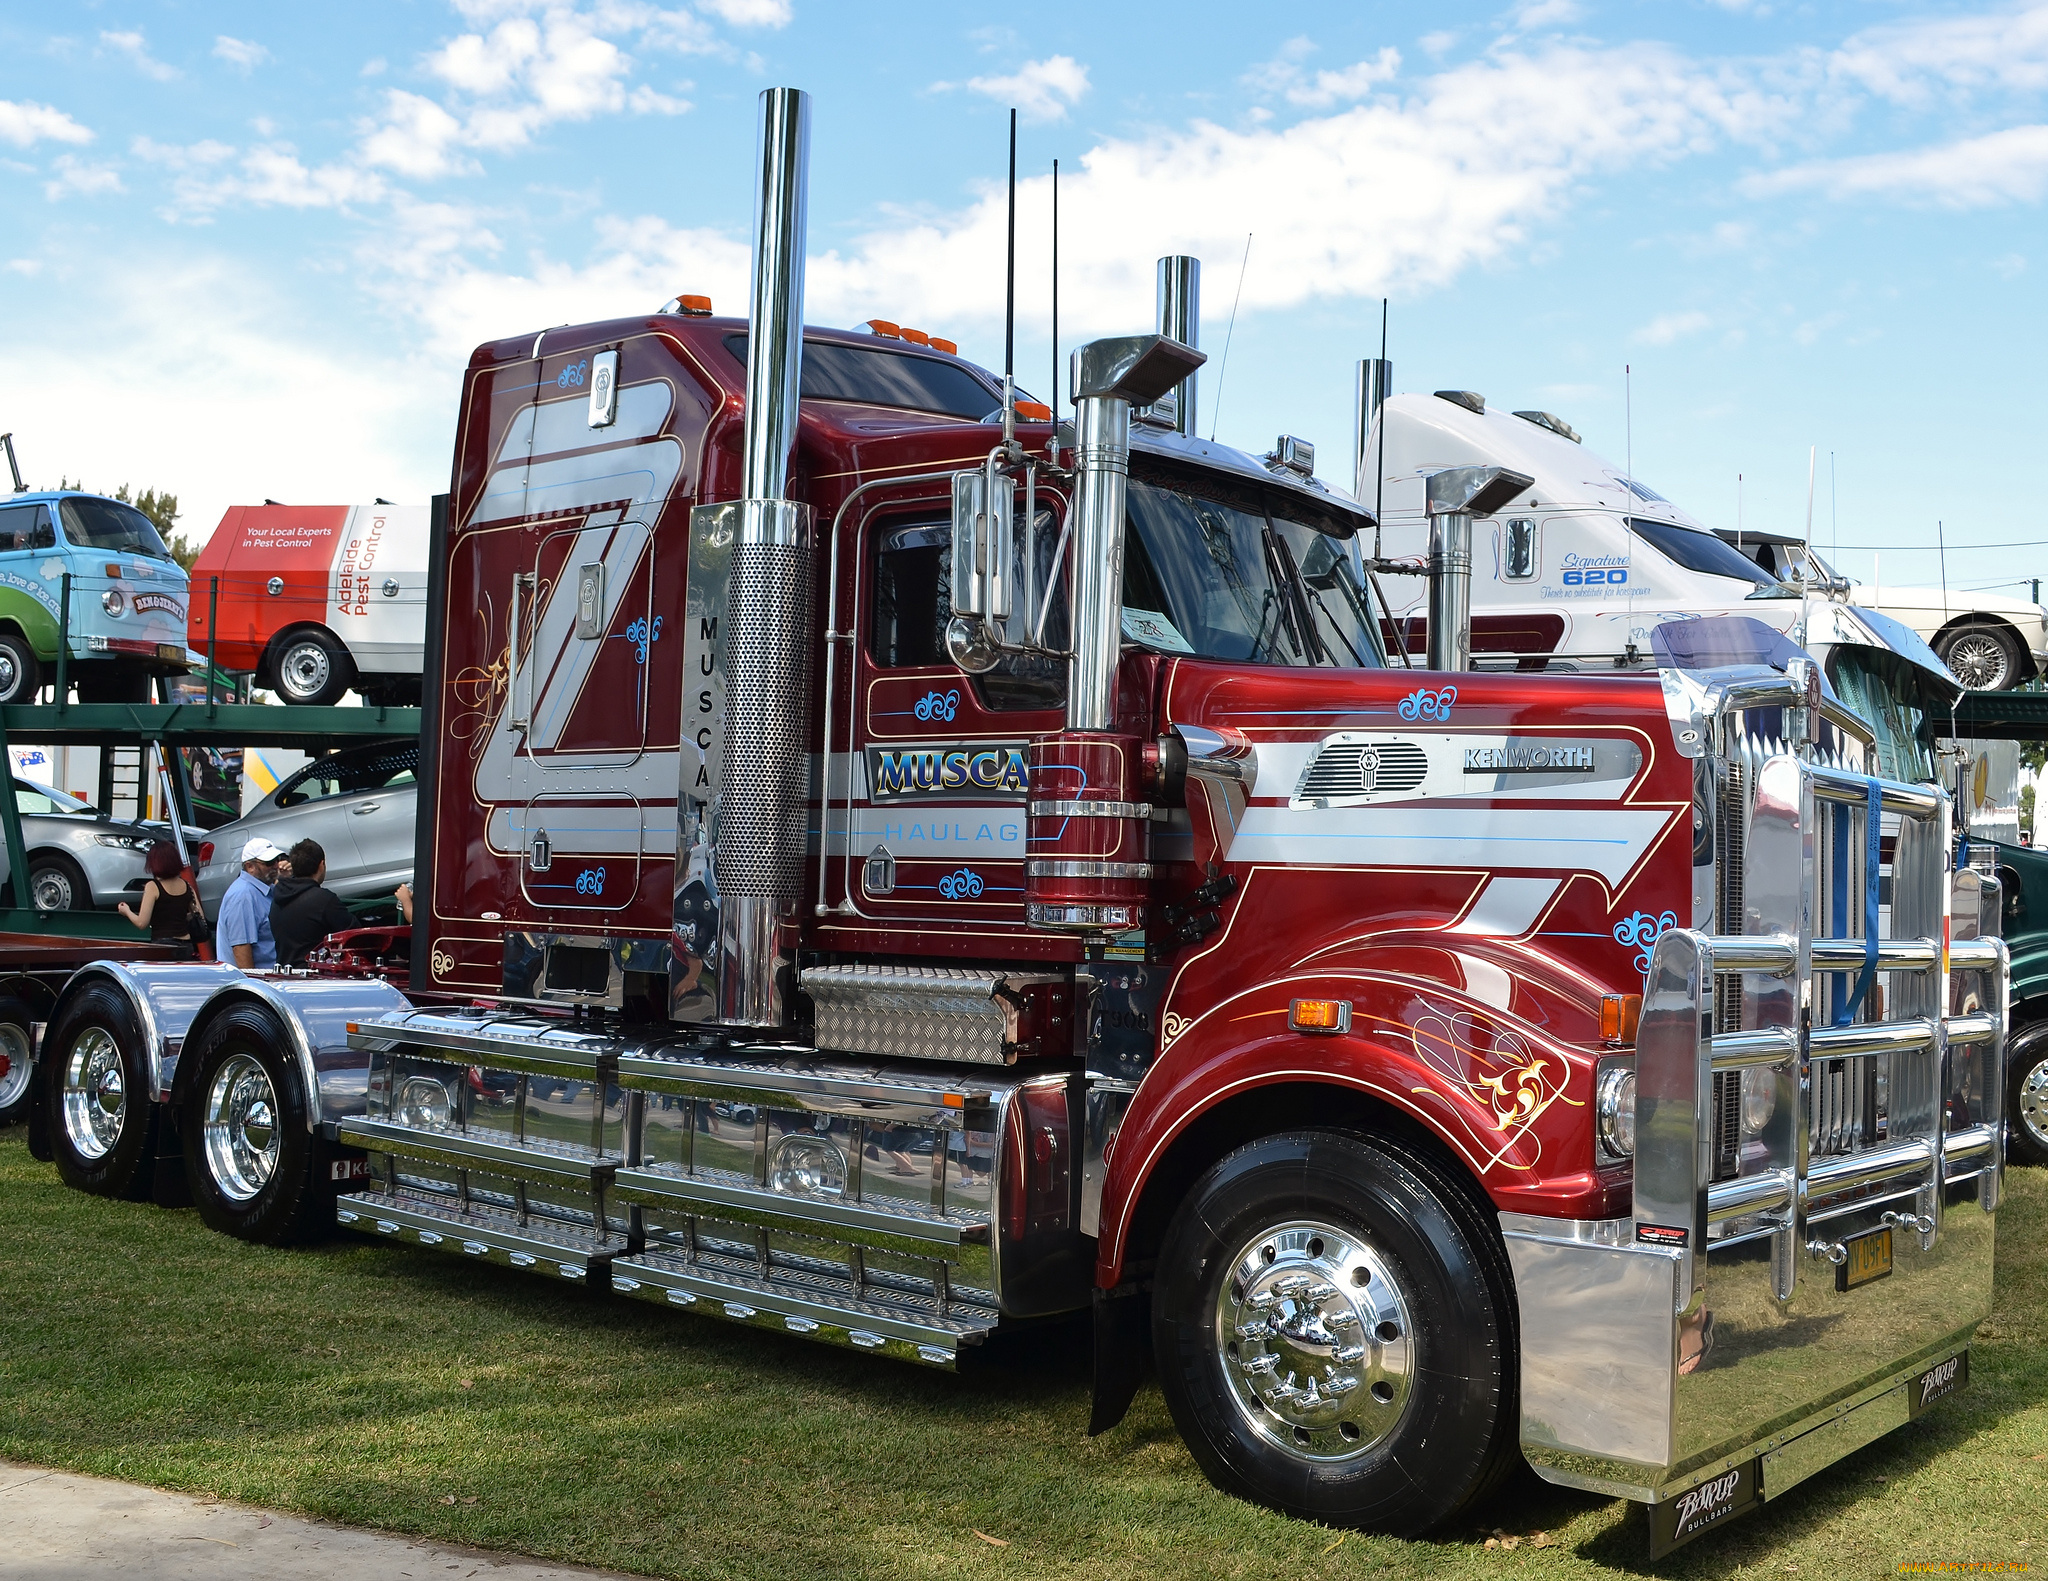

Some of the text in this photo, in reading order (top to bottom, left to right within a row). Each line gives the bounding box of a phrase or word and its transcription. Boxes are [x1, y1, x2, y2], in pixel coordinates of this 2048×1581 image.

[242, 538, 312, 548] in Pest Control
[247, 527, 332, 538] Your Local Experts
[354, 516, 387, 616] Pest Control
[1561, 553, 1630, 571] Signature
[7, 572, 27, 587] love
[27, 581, 39, 591] &
[36, 587, 50, 601] ice
[337, 539, 362, 616] Adelaide
[1563, 569, 1628, 585] 620
[1564, 589, 1572, 598] no
[1604, 586, 1614, 600] for
[695, 616, 718, 824] MUSCAT
[1464, 746, 1593, 768] KENWORTH
[875, 748, 1029, 796] MUSCA
[885, 823, 1019, 842] HAULAG
[1688, 1503, 1733, 1532] BULLBARS
